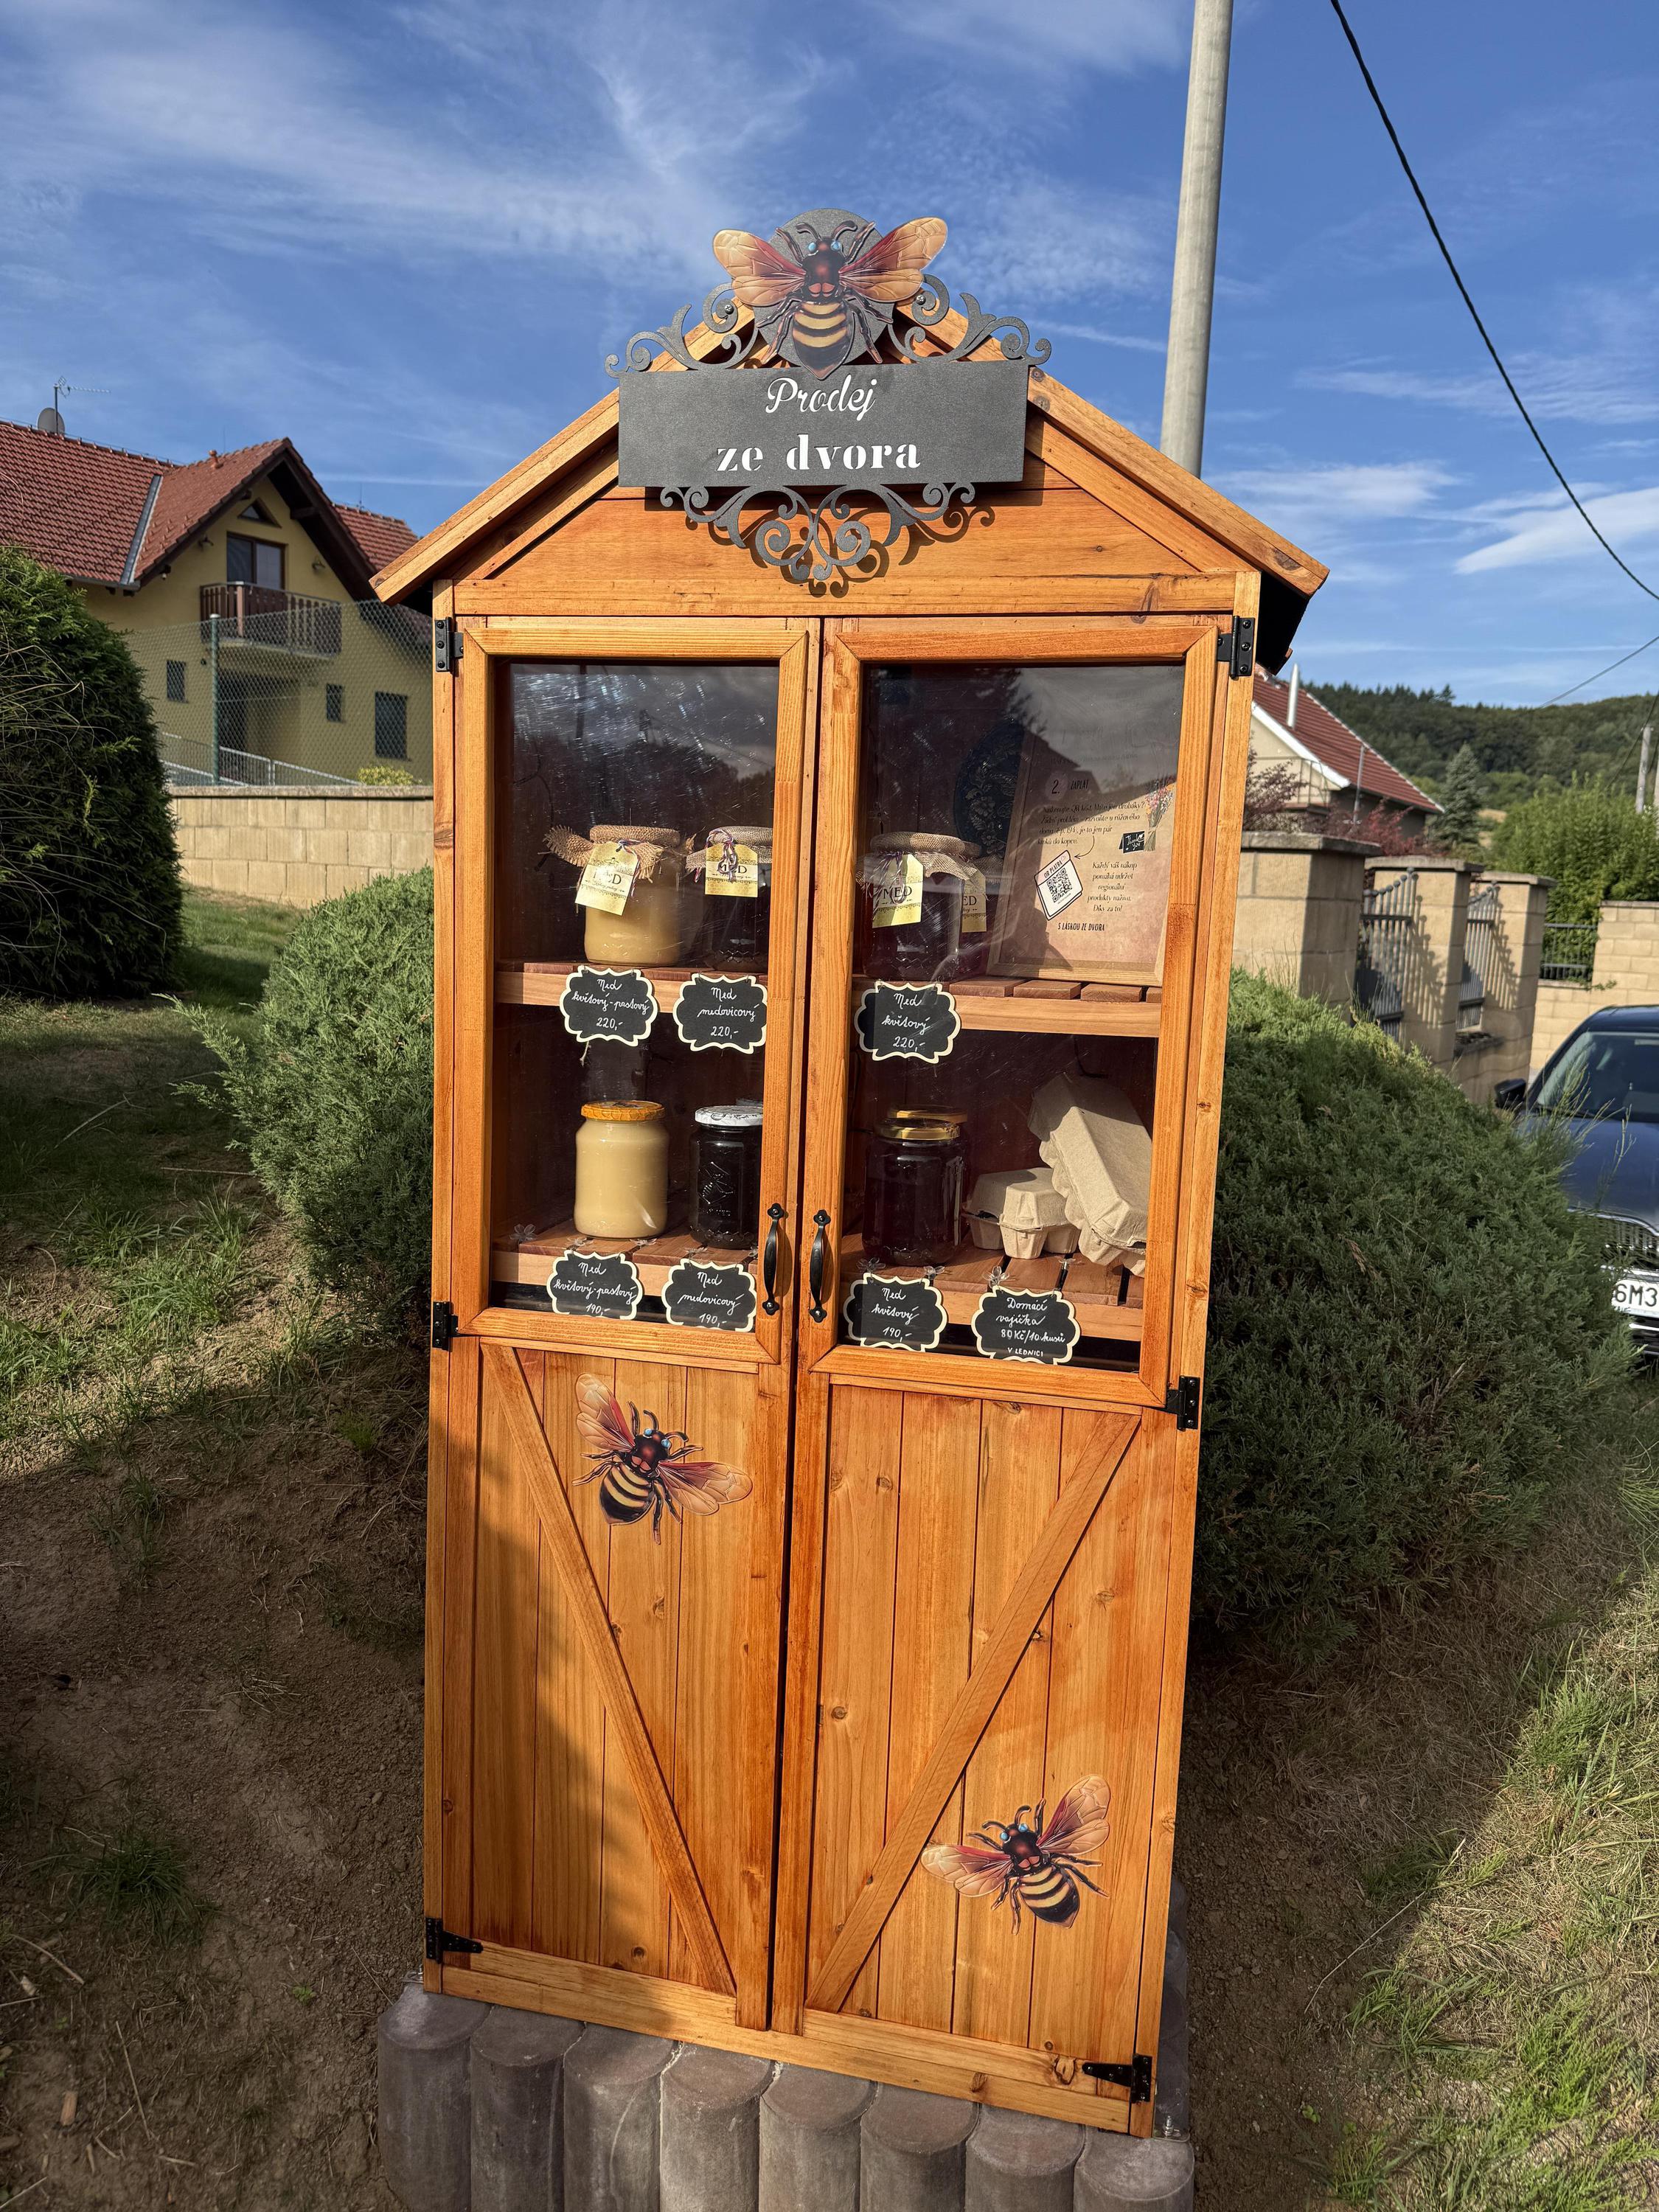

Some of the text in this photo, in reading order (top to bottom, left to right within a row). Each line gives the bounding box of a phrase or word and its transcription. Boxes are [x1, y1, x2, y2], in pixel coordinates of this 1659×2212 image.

[765, 374, 877, 421] Prodej
[717, 433, 920, 471] ze dvora
[1051, 779, 1060, 794] 2.
[1092, 861, 1110, 871] Každý
[1120, 861, 1138, 871] nákup
[1062, 921, 1080, 931] LÁSKOU
[1081, 922, 1087, 931] ZE
[1088, 922, 1105, 931] DVORA
[597, 979, 622, 992] Med
[711, 987, 737, 1002] Med
[894, 992, 922, 1009] Med
[697, 1004, 759, 1022] medovicový
[881, 1015, 931, 1035] květový
[578, 1262, 607, 1276] Med
[697, 1271, 723, 1288] Med
[882, 1287, 906, 1301] Med
[1614, 1283, 1658, 1307] 6M3
[677, 1291, 745, 1315] medovicový
[1006, 1297, 1047, 1311] Domácí
[871, 1303, 919, 1325] květový
[995, 1314, 1046, 1328] vajíčka
[1015, 1348, 1043, 1357] LEDNICI
